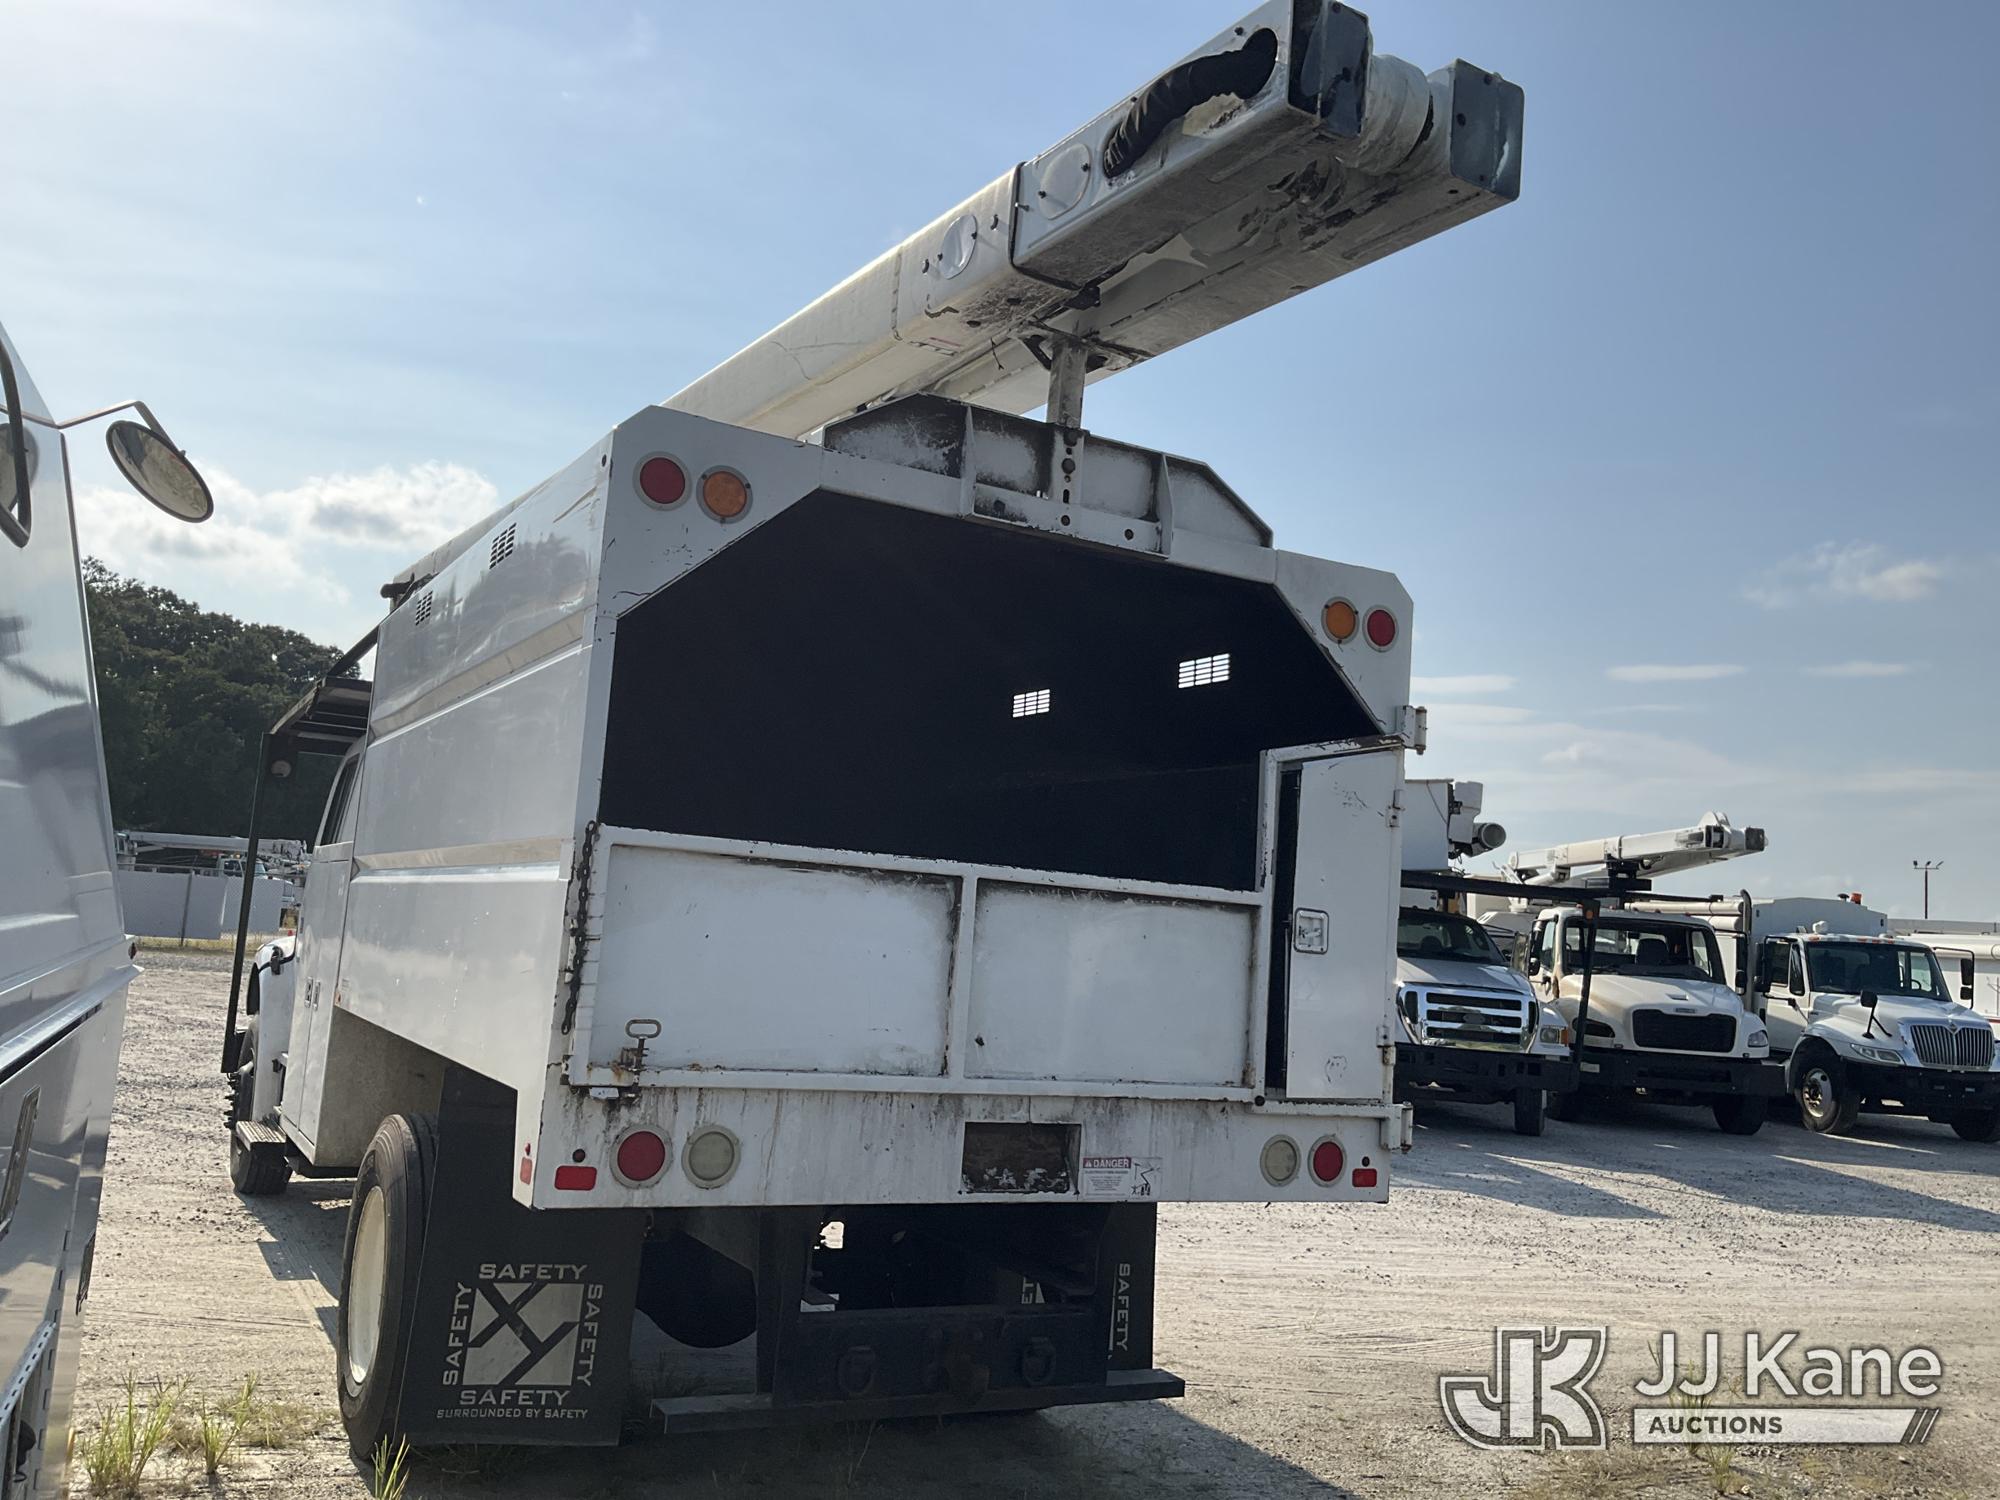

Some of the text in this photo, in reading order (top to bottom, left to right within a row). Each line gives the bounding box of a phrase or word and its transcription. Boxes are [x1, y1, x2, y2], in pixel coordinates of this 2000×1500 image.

[1093, 1159, 1129, 1168] DANGER
[478, 1263, 588, 1280] SAFETY
[1115, 1262, 1131, 1351] SAFETY
[442, 1281, 472, 1385] SAFETY
[576, 1283, 604, 1387] SAFETY
[459, 1389, 570, 1406] SAFETY
[436, 1408, 589, 1419] SURROUNDED BY SAFETY
